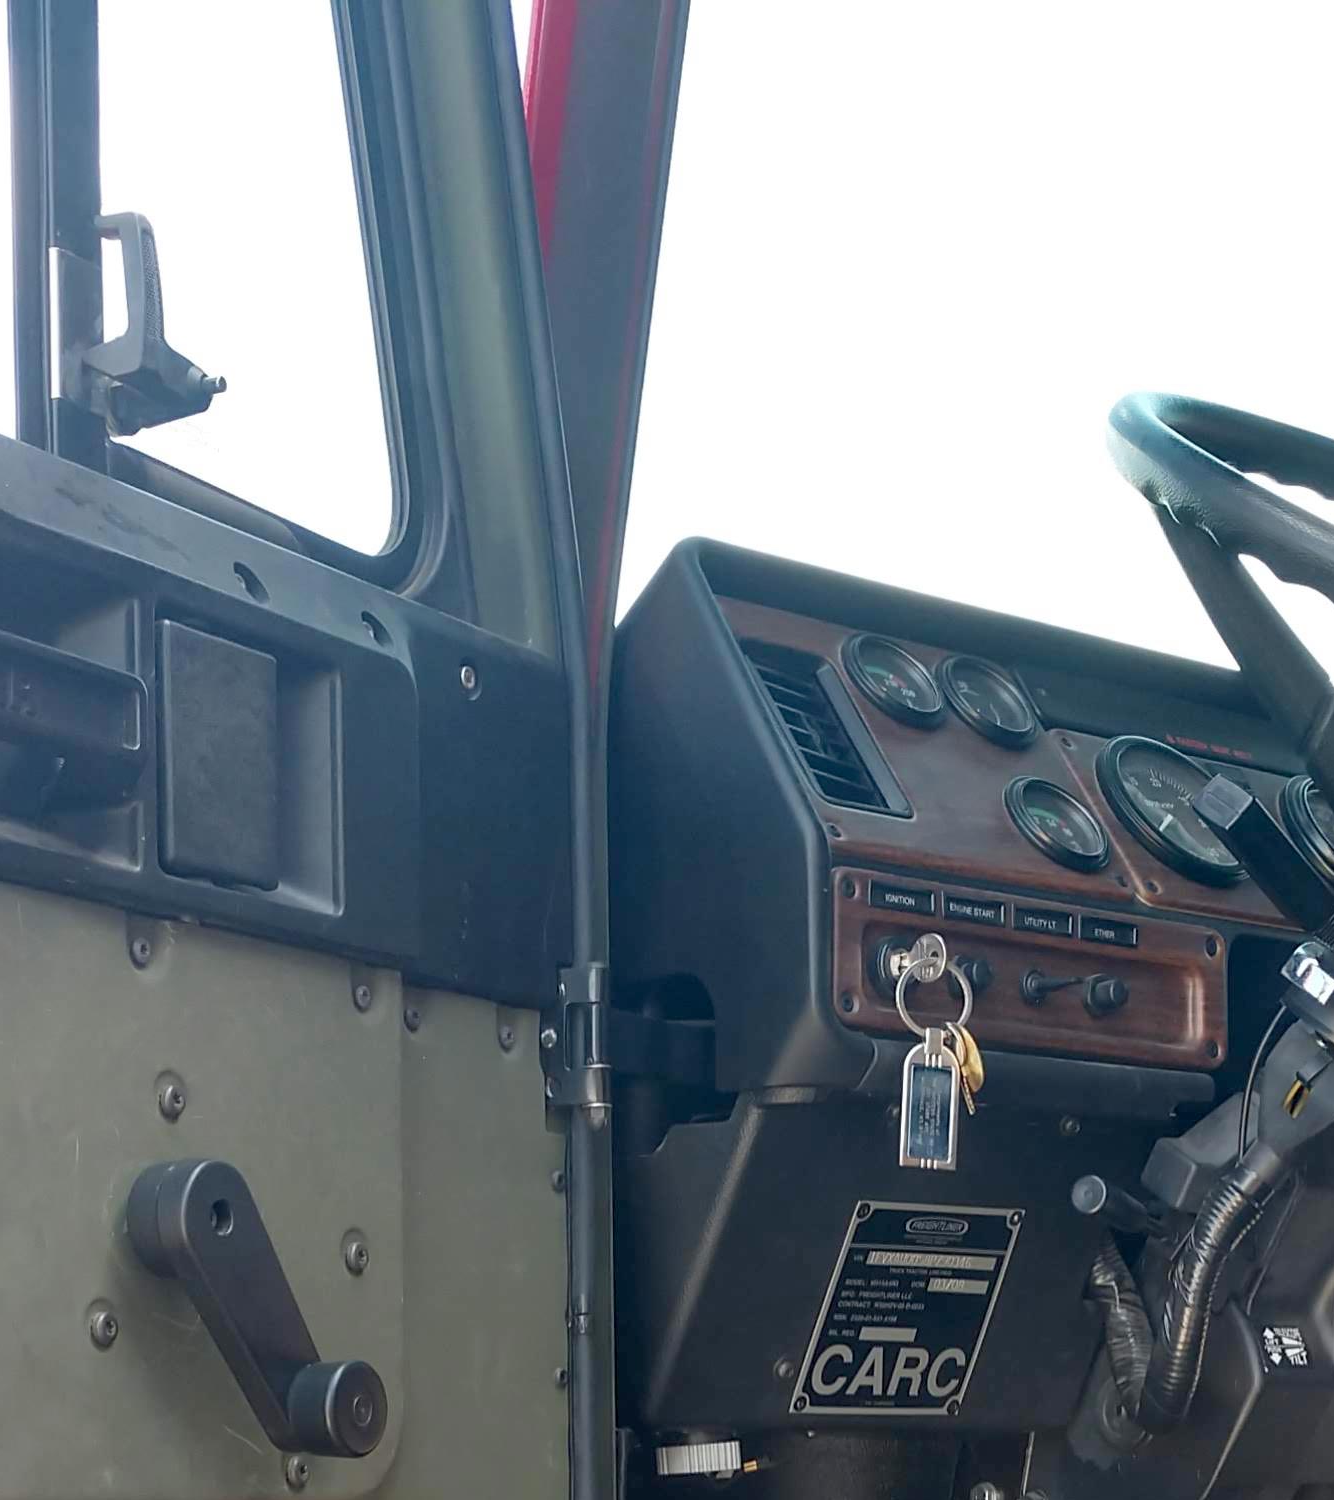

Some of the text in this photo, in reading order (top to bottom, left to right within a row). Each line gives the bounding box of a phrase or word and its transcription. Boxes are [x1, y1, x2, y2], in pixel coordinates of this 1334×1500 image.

[884, 893, 916, 907] IGNITION
[949, 903, 996, 920] ENGINE START
[810, 1343, 967, 1398] CARC
